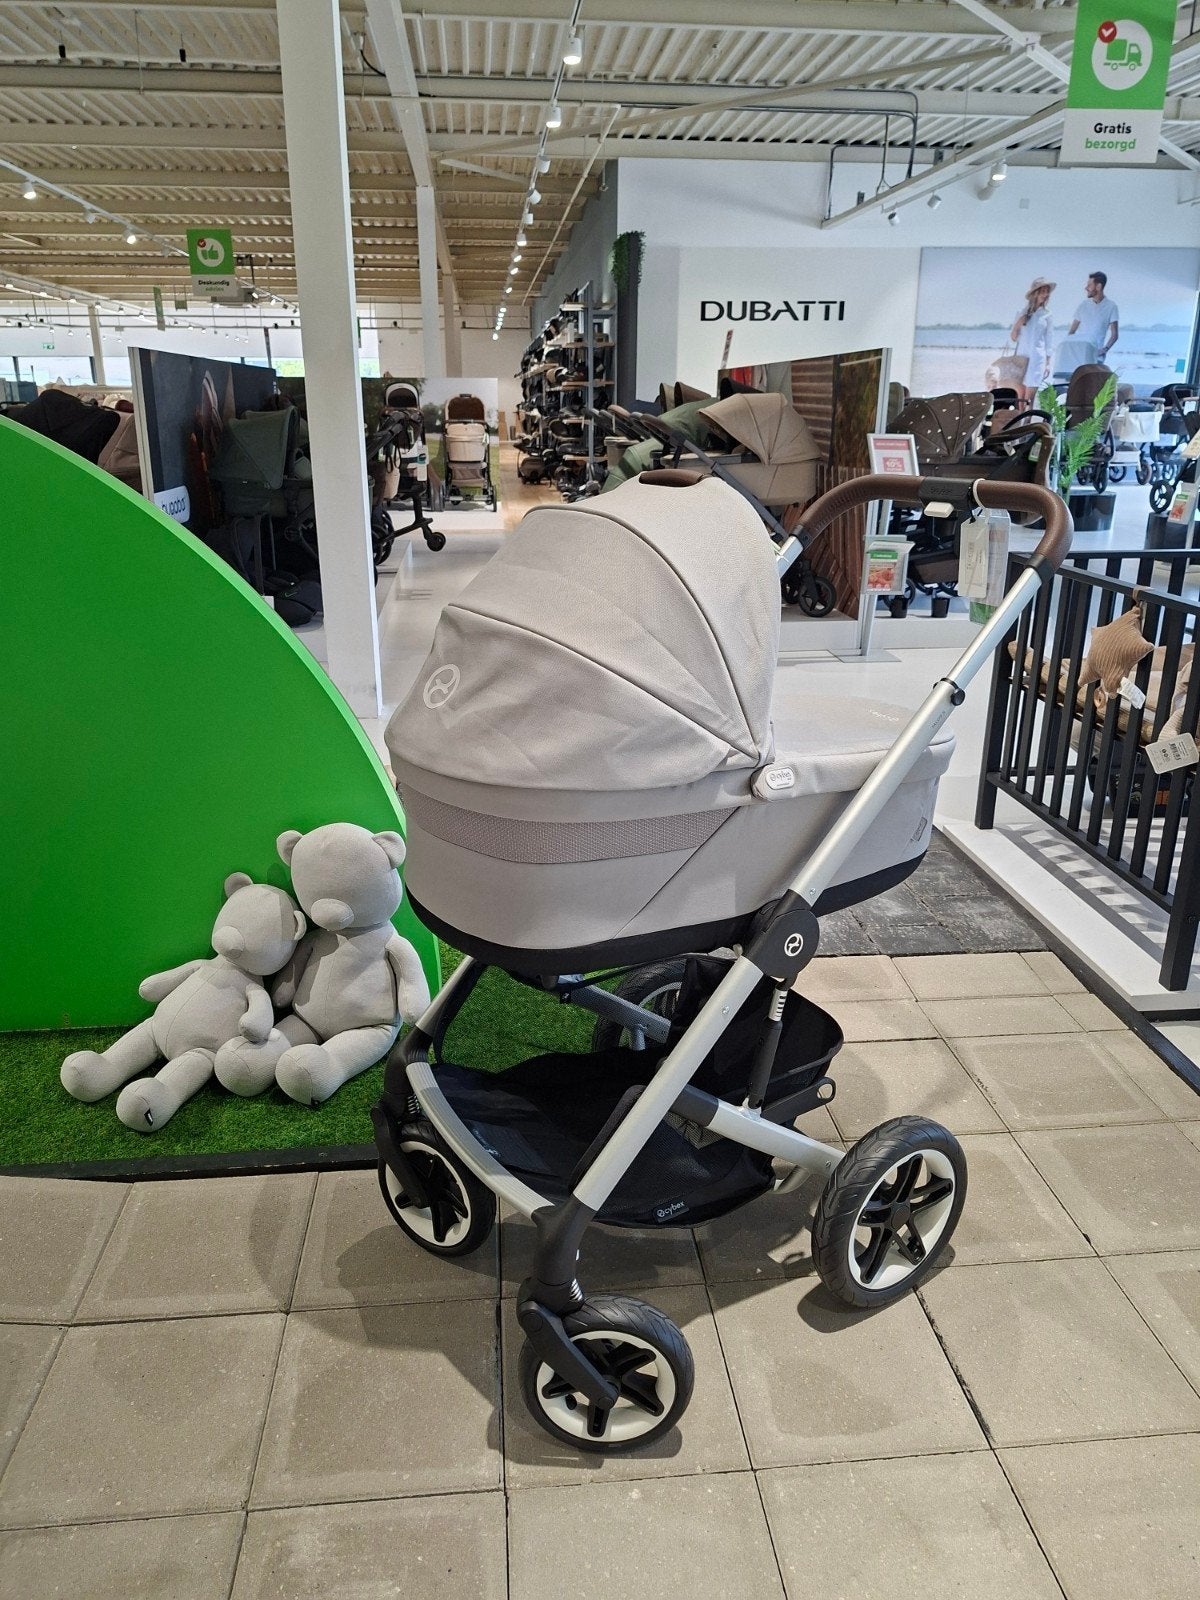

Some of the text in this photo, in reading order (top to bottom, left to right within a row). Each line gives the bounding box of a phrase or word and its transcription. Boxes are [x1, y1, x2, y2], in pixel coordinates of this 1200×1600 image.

[1093, 122, 1132, 134] Gratis
[1085, 138, 1136, 152] bezorgd
[700, 300, 845, 321] DUBATTI
[664, 1201, 685, 1215] cybex
